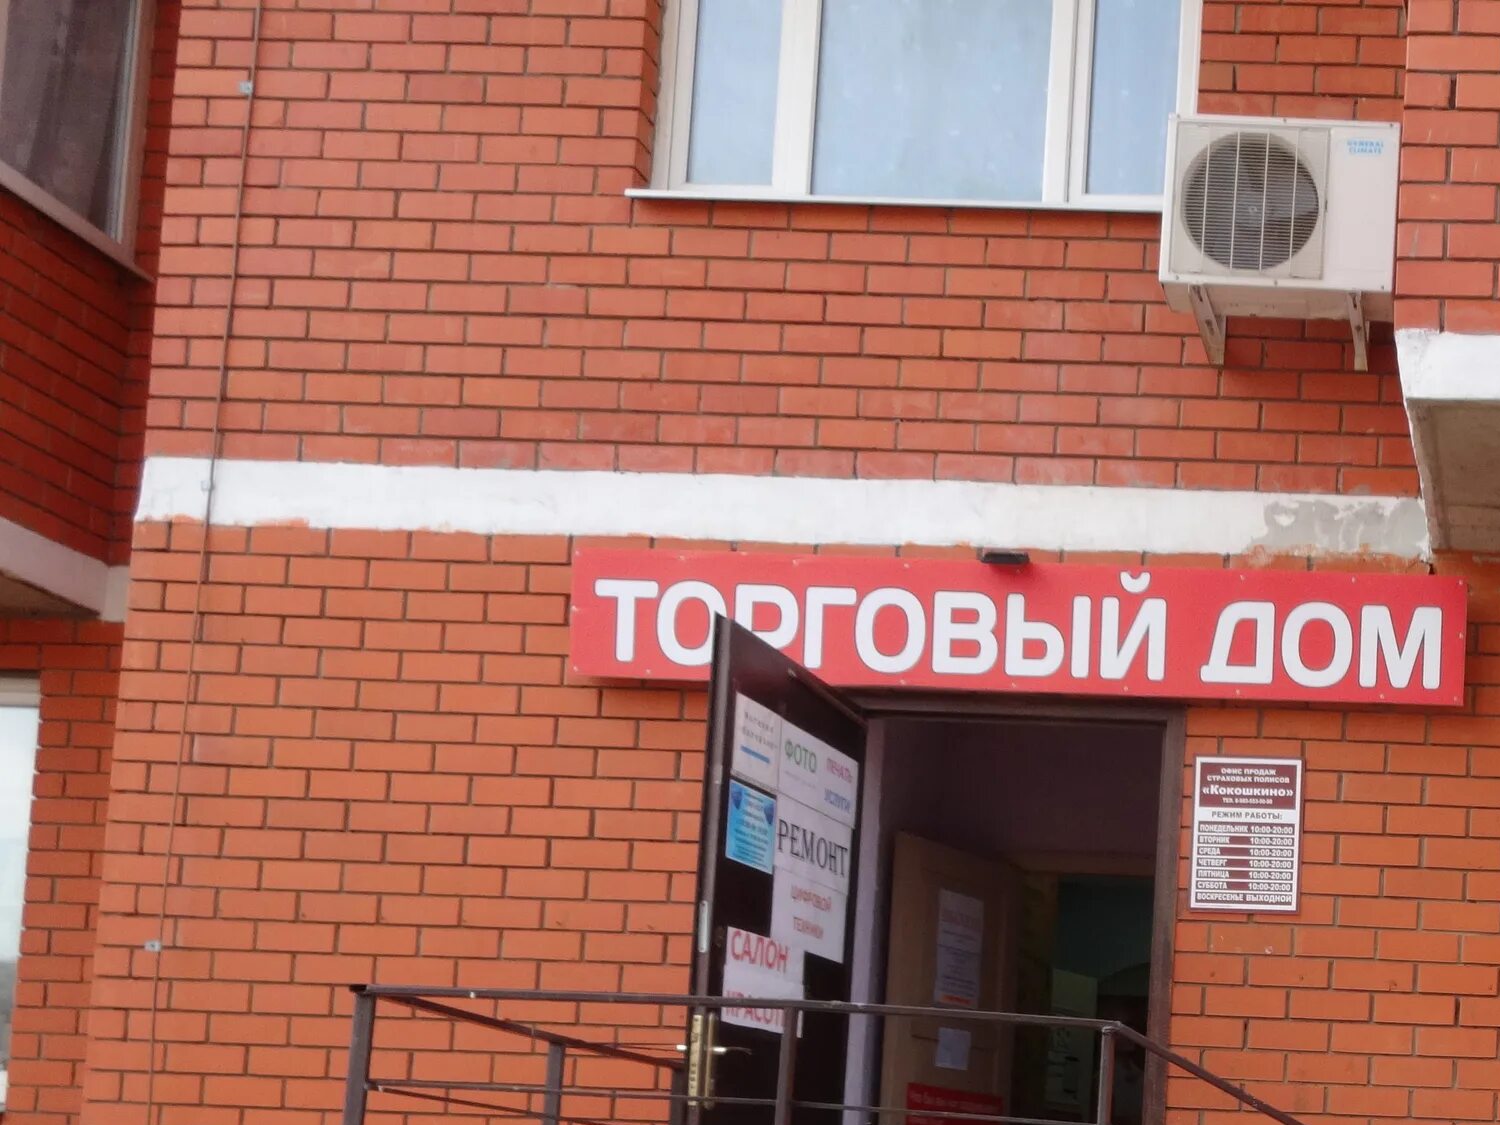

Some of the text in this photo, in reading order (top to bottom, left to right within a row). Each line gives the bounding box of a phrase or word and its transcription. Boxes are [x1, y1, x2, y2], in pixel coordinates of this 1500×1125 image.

[594, 571, 1443, 689] ТОРГОВЫЙ ДОМ
[784, 739, 818, 773] ФОТО
[1244, 768, 1276, 776] ПРОДАЖ
[1207, 775, 1290, 784] СТРАХОВЫХ ПОЛИСОВ
[1202, 784, 1294, 797] «Кокошкино»
[1212, 811, 1283, 820] РЕЖИМ РАБОТЫ:
[1199, 824, 1248, 833] ПОНЕДЕЛЬНИК
[1199, 836, 1230, 844] ВТОРНИК
[777, 818, 848, 877] РЕМОНТ
[1197, 870, 1230, 878] ПЯТНИЦА
[1197, 881, 1227, 889] СУББОТА
[1196, 893, 1243, 901] ВОСКРЕСЕНЬЕ
[731, 930, 788, 973] САЛОН
